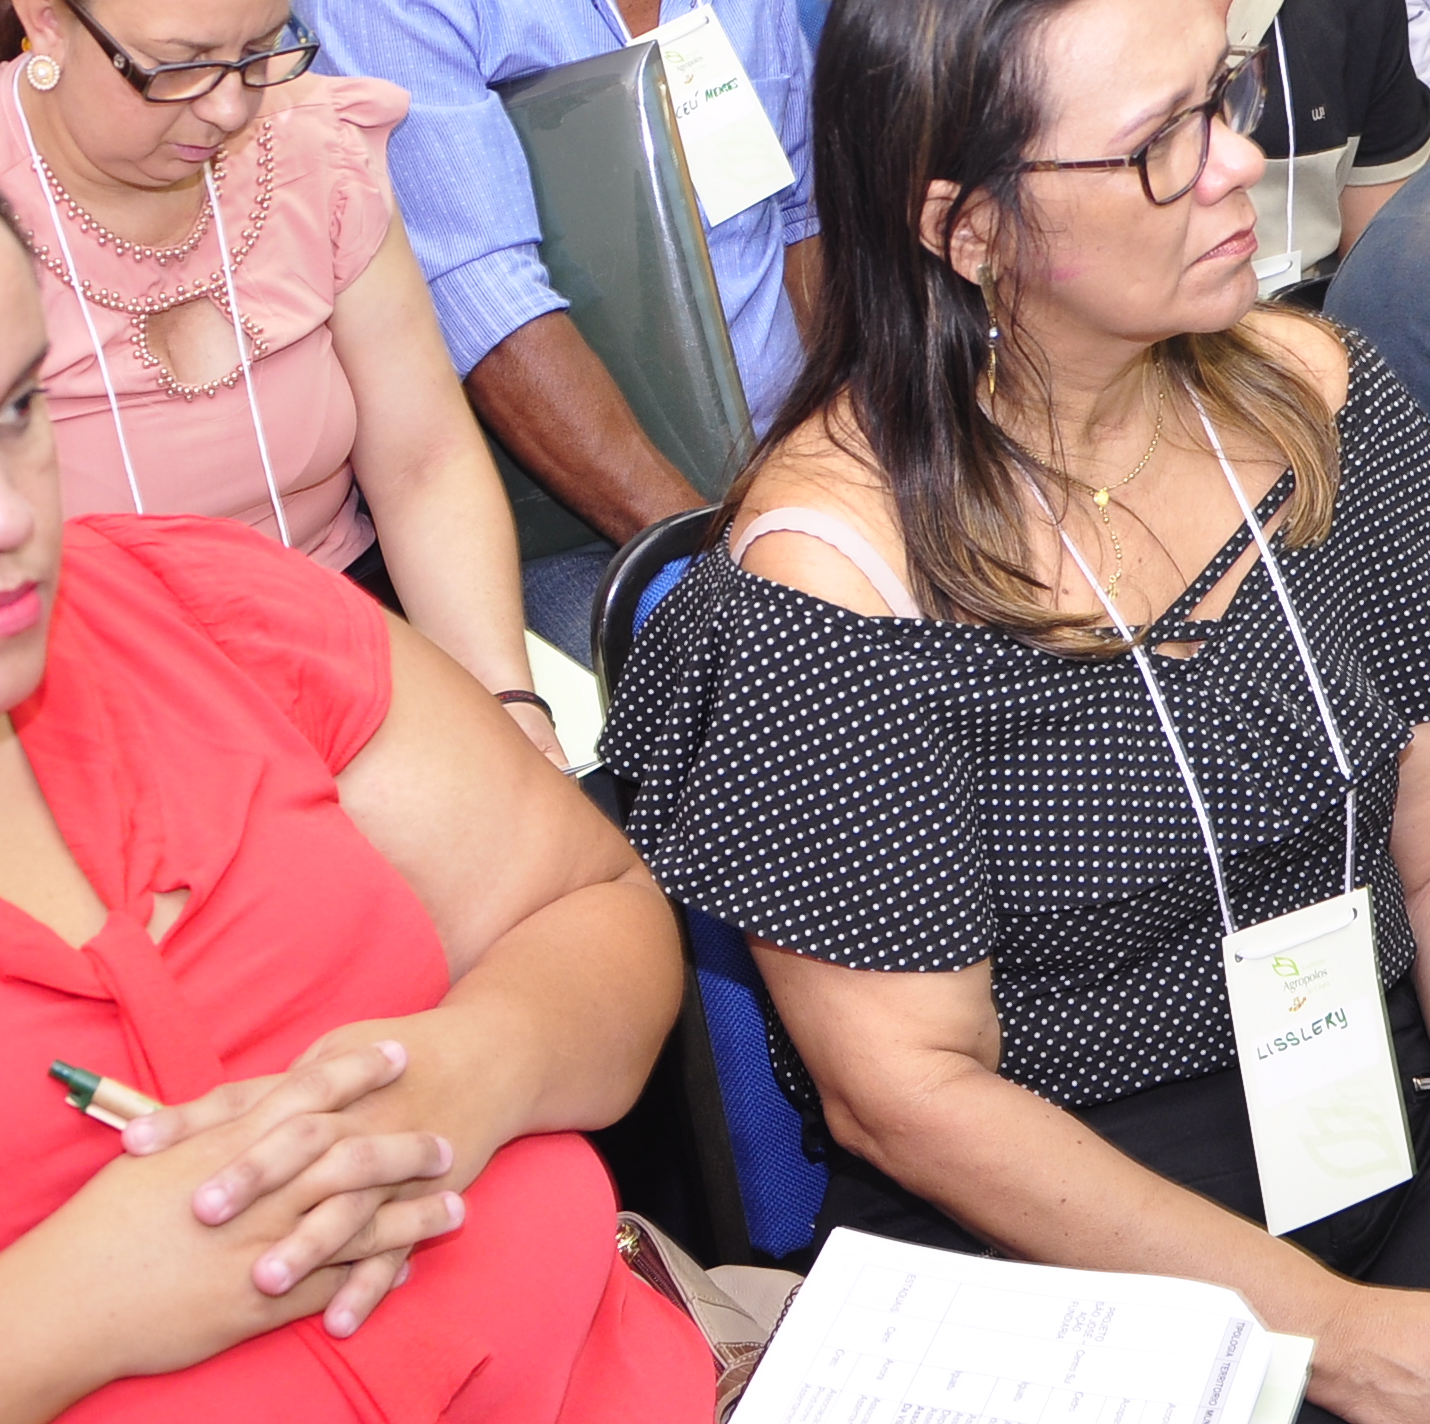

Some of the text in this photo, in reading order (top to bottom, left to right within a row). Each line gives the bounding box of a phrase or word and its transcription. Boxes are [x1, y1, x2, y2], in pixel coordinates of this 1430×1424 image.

[1283, 968, 1328, 994] Agropolos
[1257, 1007, 1349, 1061] LISSLERY
[890, 1273, 917, 1313] ESTADUAIS
[1094, 1306, 1116, 1342] PROJETO
[1225, 1321, 1246, 1358] TIPOLOGIA
[875, 1357, 894, 1380] Aurora
[1067, 1391, 1084, 1413] Cedro
